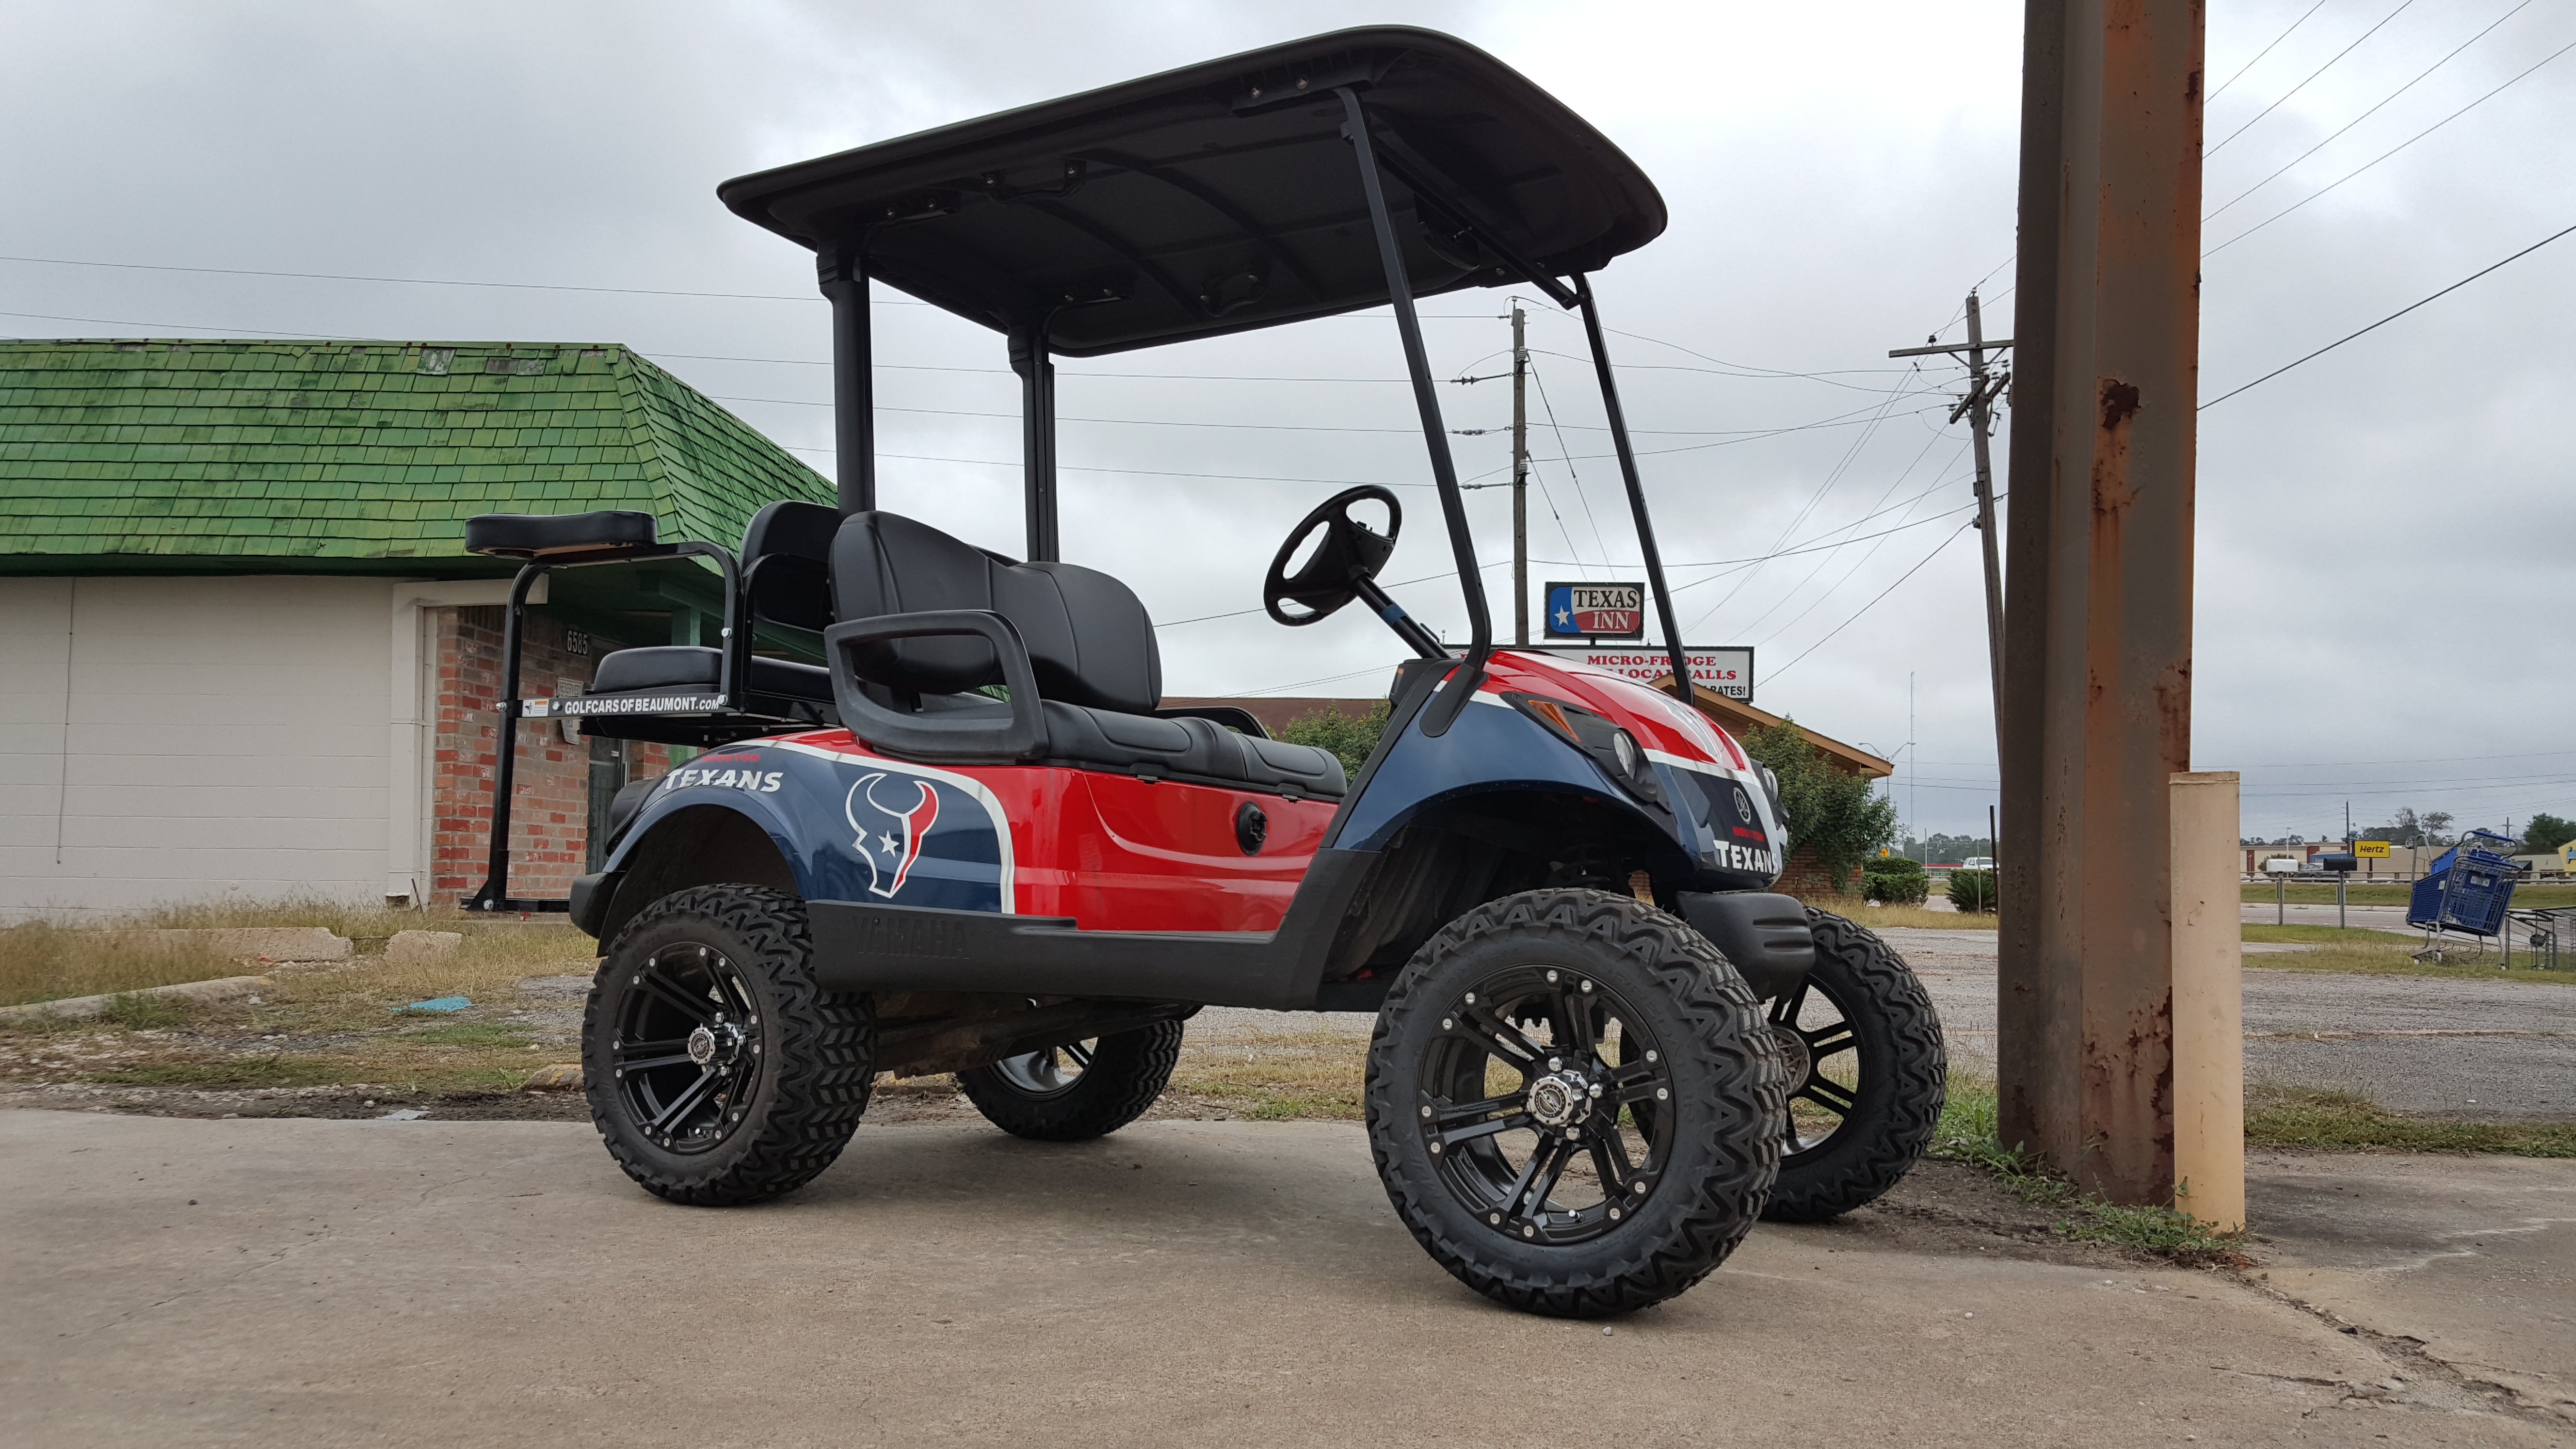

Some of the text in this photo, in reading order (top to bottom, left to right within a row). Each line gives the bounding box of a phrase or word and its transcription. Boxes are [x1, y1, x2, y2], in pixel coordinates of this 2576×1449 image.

[1573, 590, 1637, 609] TEXAS
[1593, 611, 1630, 630] INN
[567, 630, 588, 655] 6585
[1587, 656, 1717, 666] MICRO-FRGE
[1689, 670, 1737, 680] ALLS
[701, 754, 760, 763] HOUSTON
[665, 768, 784, 792] TEXANS
[1713, 839, 1778, 874] TEXANS
